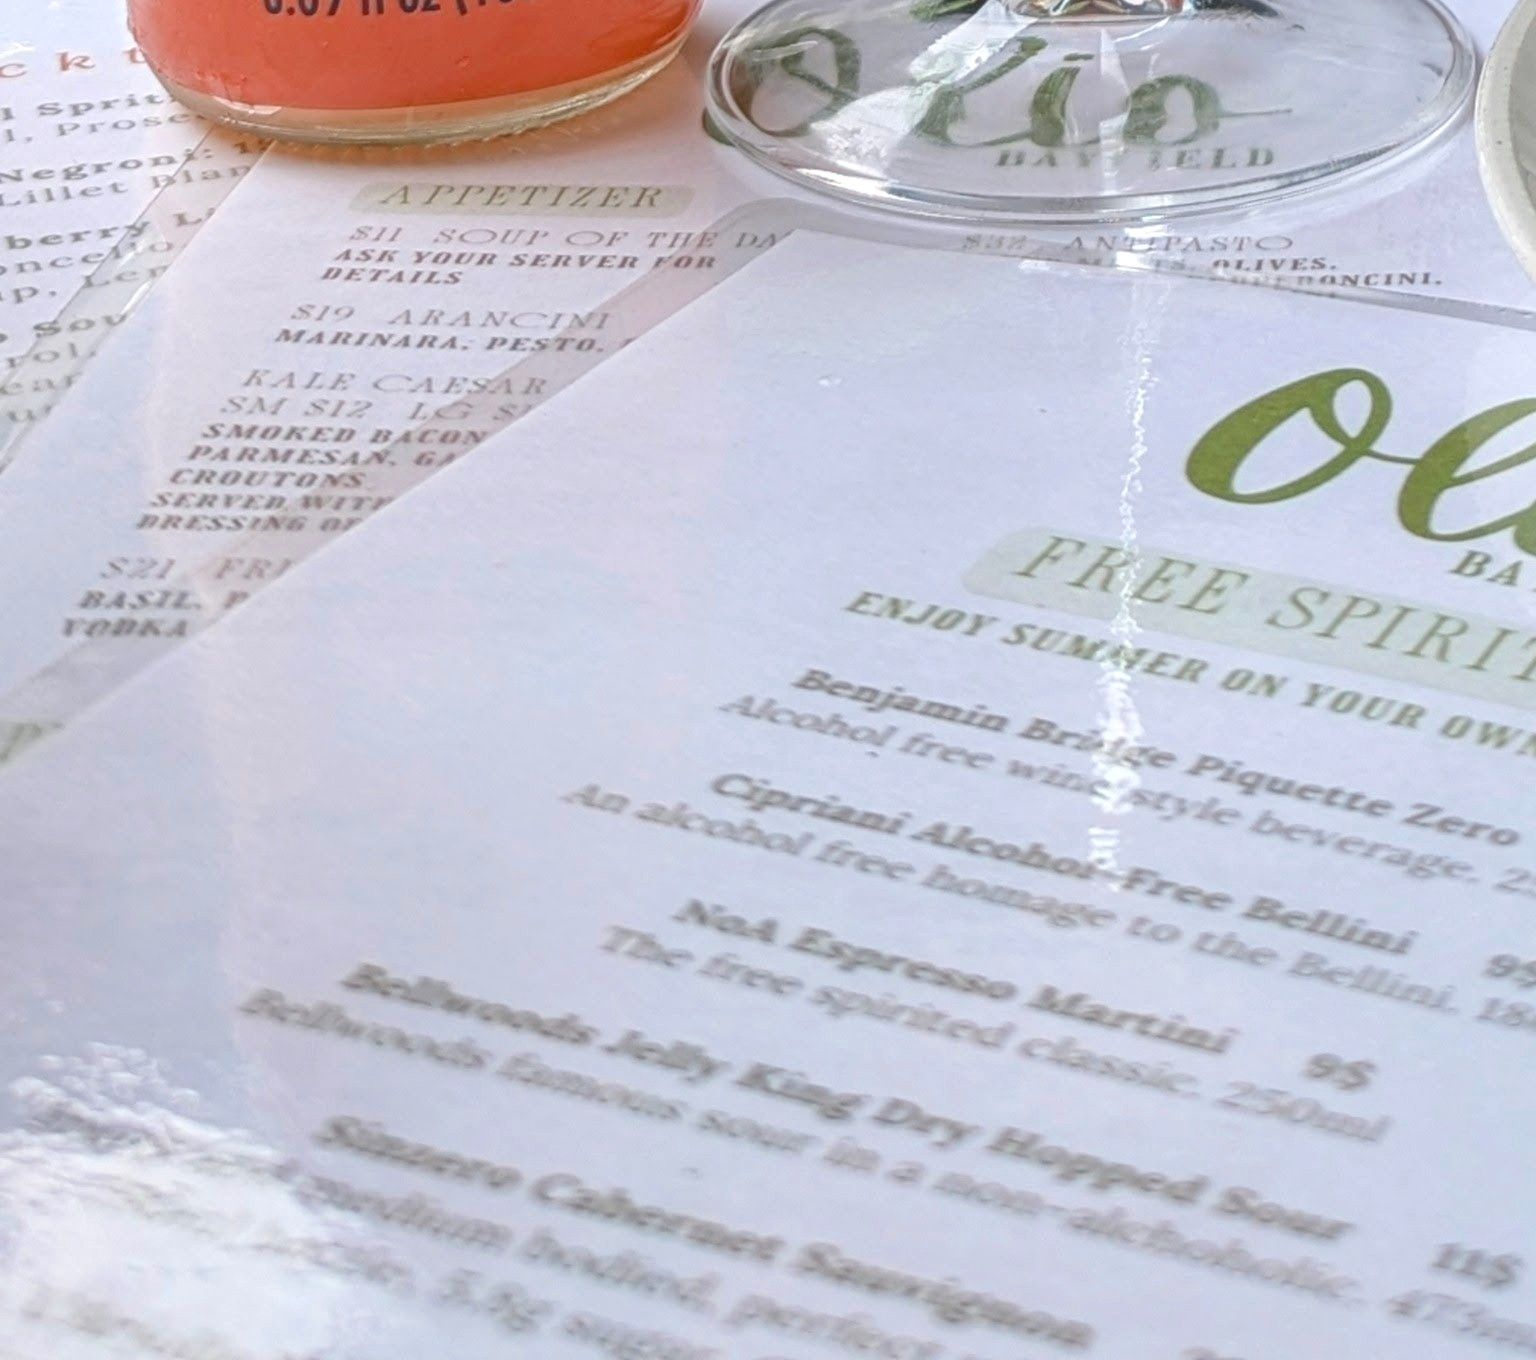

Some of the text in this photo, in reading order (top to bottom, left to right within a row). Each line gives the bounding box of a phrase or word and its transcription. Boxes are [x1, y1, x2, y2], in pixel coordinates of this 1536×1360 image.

[379, 184, 663, 209] APPETIZER
[433, 229, 549, 246] SOUP
[566, 230, 629, 247] OF
[647, 231, 718, 249] THE
[334, 248, 716, 269] ASK YOUR SERVER FOR
[321, 267, 464, 285] DETAILS
[388, 309, 610, 330] ARANCINI
[243, 369, 547, 395] KALE CAESAR
[220, 396, 288, 416] SM
[202, 423, 356, 442] SMOKED
[151, 492, 287, 511] SERVED
[136, 513, 307, 531] DRESSING
[1011, 535, 1251, 615] FREE
[844, 591, 1000, 637] ENJOY
[1001, 623, 1211, 683] SUMMER
[1221, 668, 1289, 698] ON
[1299, 682, 1428, 730] YOUR
[717, 695, 900, 747] Alcohol
[899, 732, 996, 769] free
[791, 668, 1009, 731] Benjamin
[1185, 753, 1396, 818] Piquette
[1402, 802, 1522, 846] Zero
[559, 784, 631, 815] An
[633, 801, 816, 858] alcohol
[813, 839, 916, 881] free
[919, 863, 1117, 929] homage
[1126, 913, 1183, 944] to
[1191, 929, 1280, 968] the
[711, 773, 913, 835] Cipriani
[1241, 895, 1419, 956] Bellini
[786, 925, 1019, 1001] Espresso
[1024, 983, 1241, 1056] Martini
